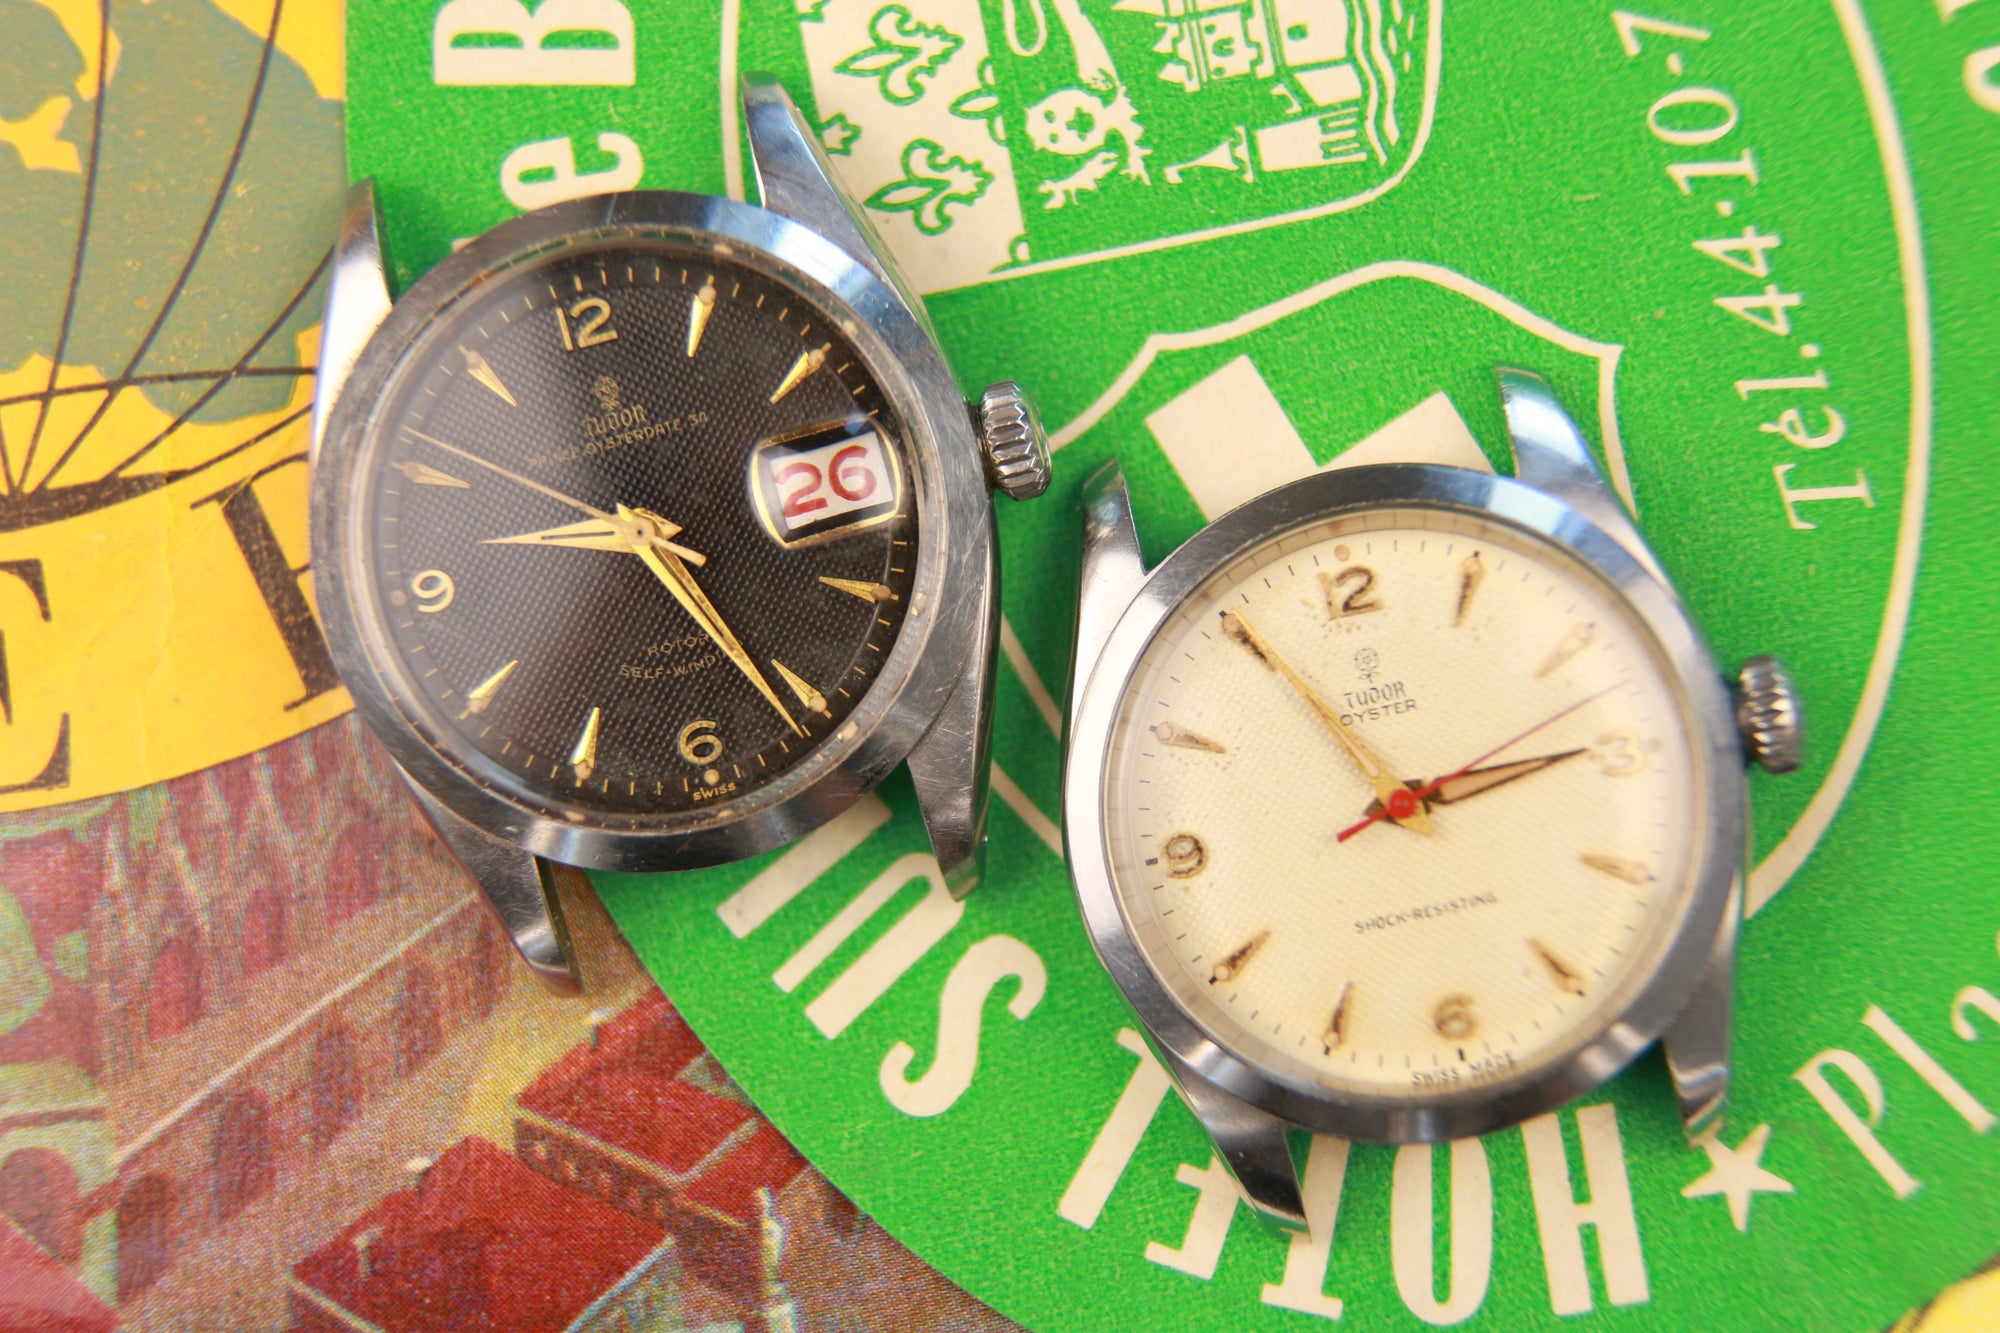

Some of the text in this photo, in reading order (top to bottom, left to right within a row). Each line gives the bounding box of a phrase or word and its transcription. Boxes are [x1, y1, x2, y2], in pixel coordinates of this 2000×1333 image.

[555, 298, 619, 351] 12
[584, 404, 647, 438] TUDOR
[586, 418, 682, 456] OYSTERDATE
[689, 411, 709, 428] 34
[775, 445, 877, 518] 26
[412, 569, 455, 613] 9
[1318, 564, 1384, 621] 12
[648, 633, 710, 658] ROTOR
[1340, 698, 1417, 727] OYSTER
[1344, 680, 1408, 709] TUDOR
[678, 719, 724, 765] 6
[693, 782, 737, 801] SWISS
[1163, 832, 1209, 879] 9
[1354, 891, 1498, 935] SHOCK-RESISTING
[1431, 993, 1479, 1042] 6
[1412, 1066, 1460, 1090] SWISS
